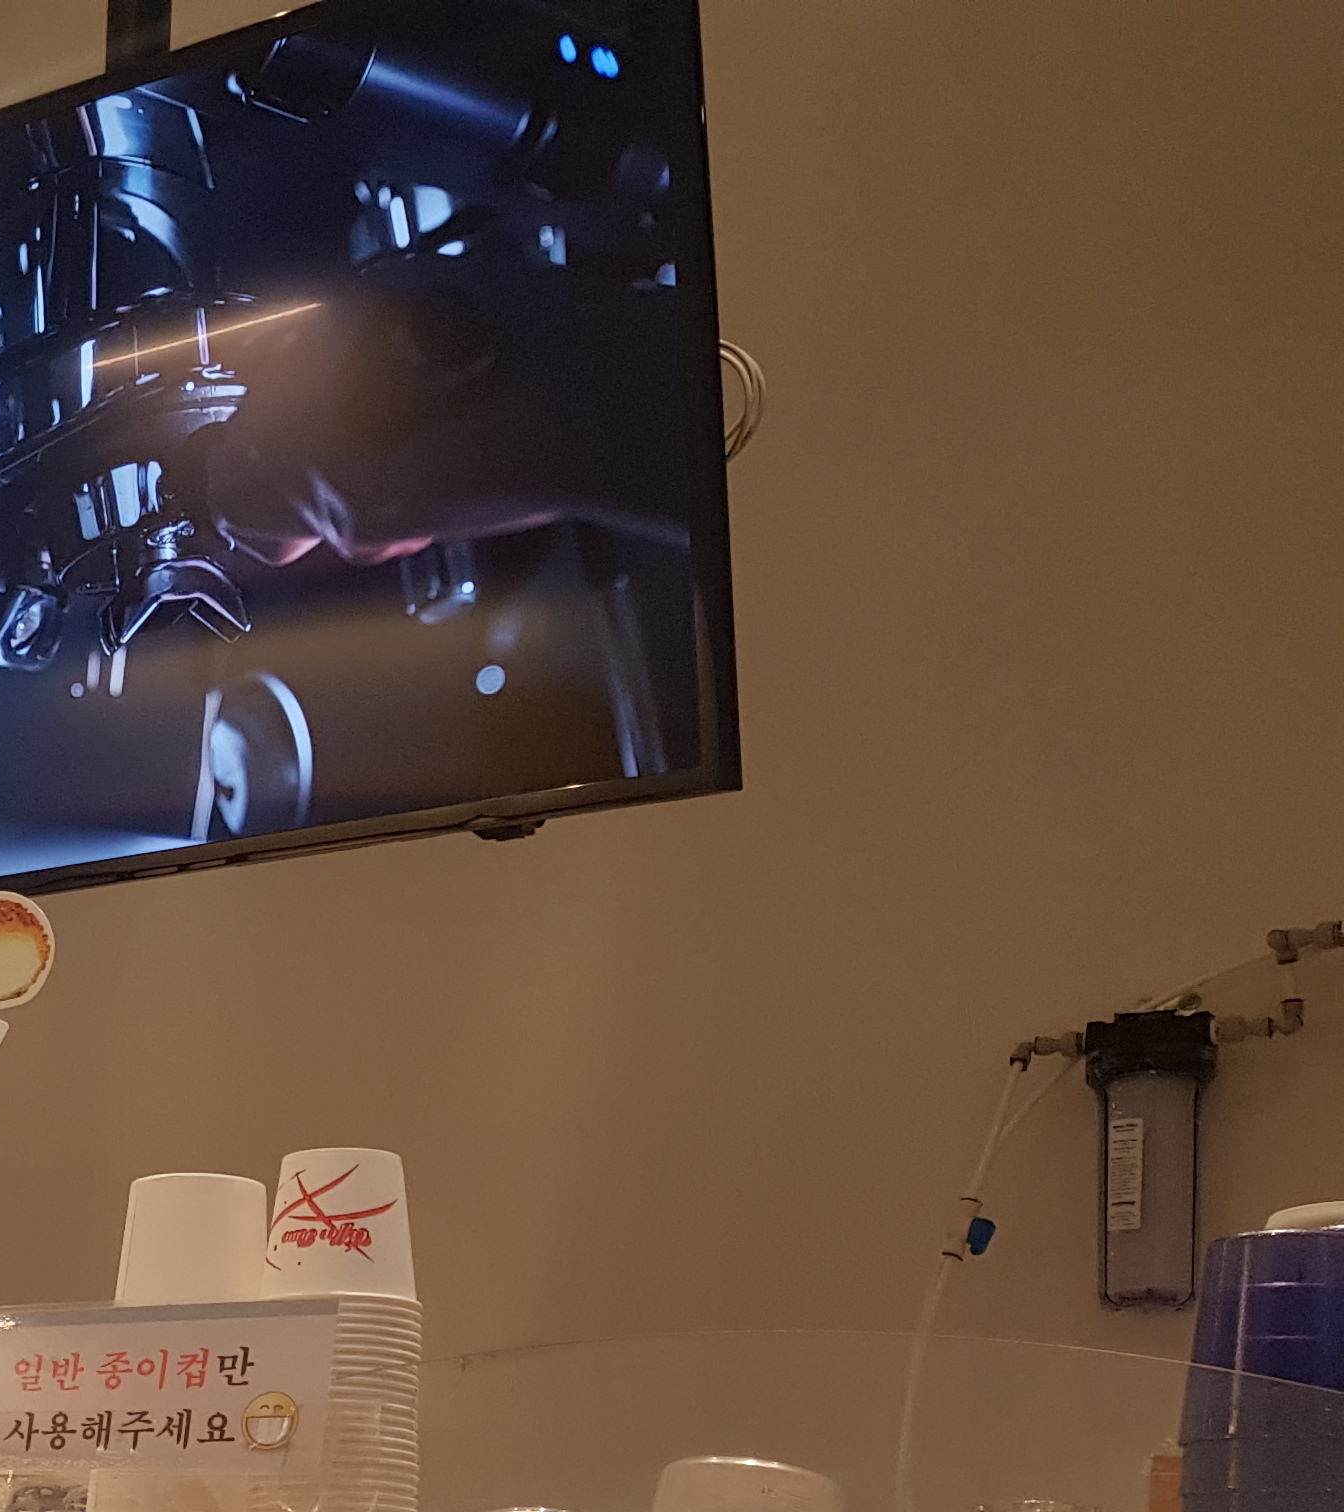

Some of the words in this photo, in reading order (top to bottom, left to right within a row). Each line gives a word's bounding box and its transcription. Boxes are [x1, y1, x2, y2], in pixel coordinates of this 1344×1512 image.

[14, 1350, 84, 1391] 일반
[97, 1346, 254, 1390] 종이컵만
[4, 1410, 236, 1451] 사용해주세요
